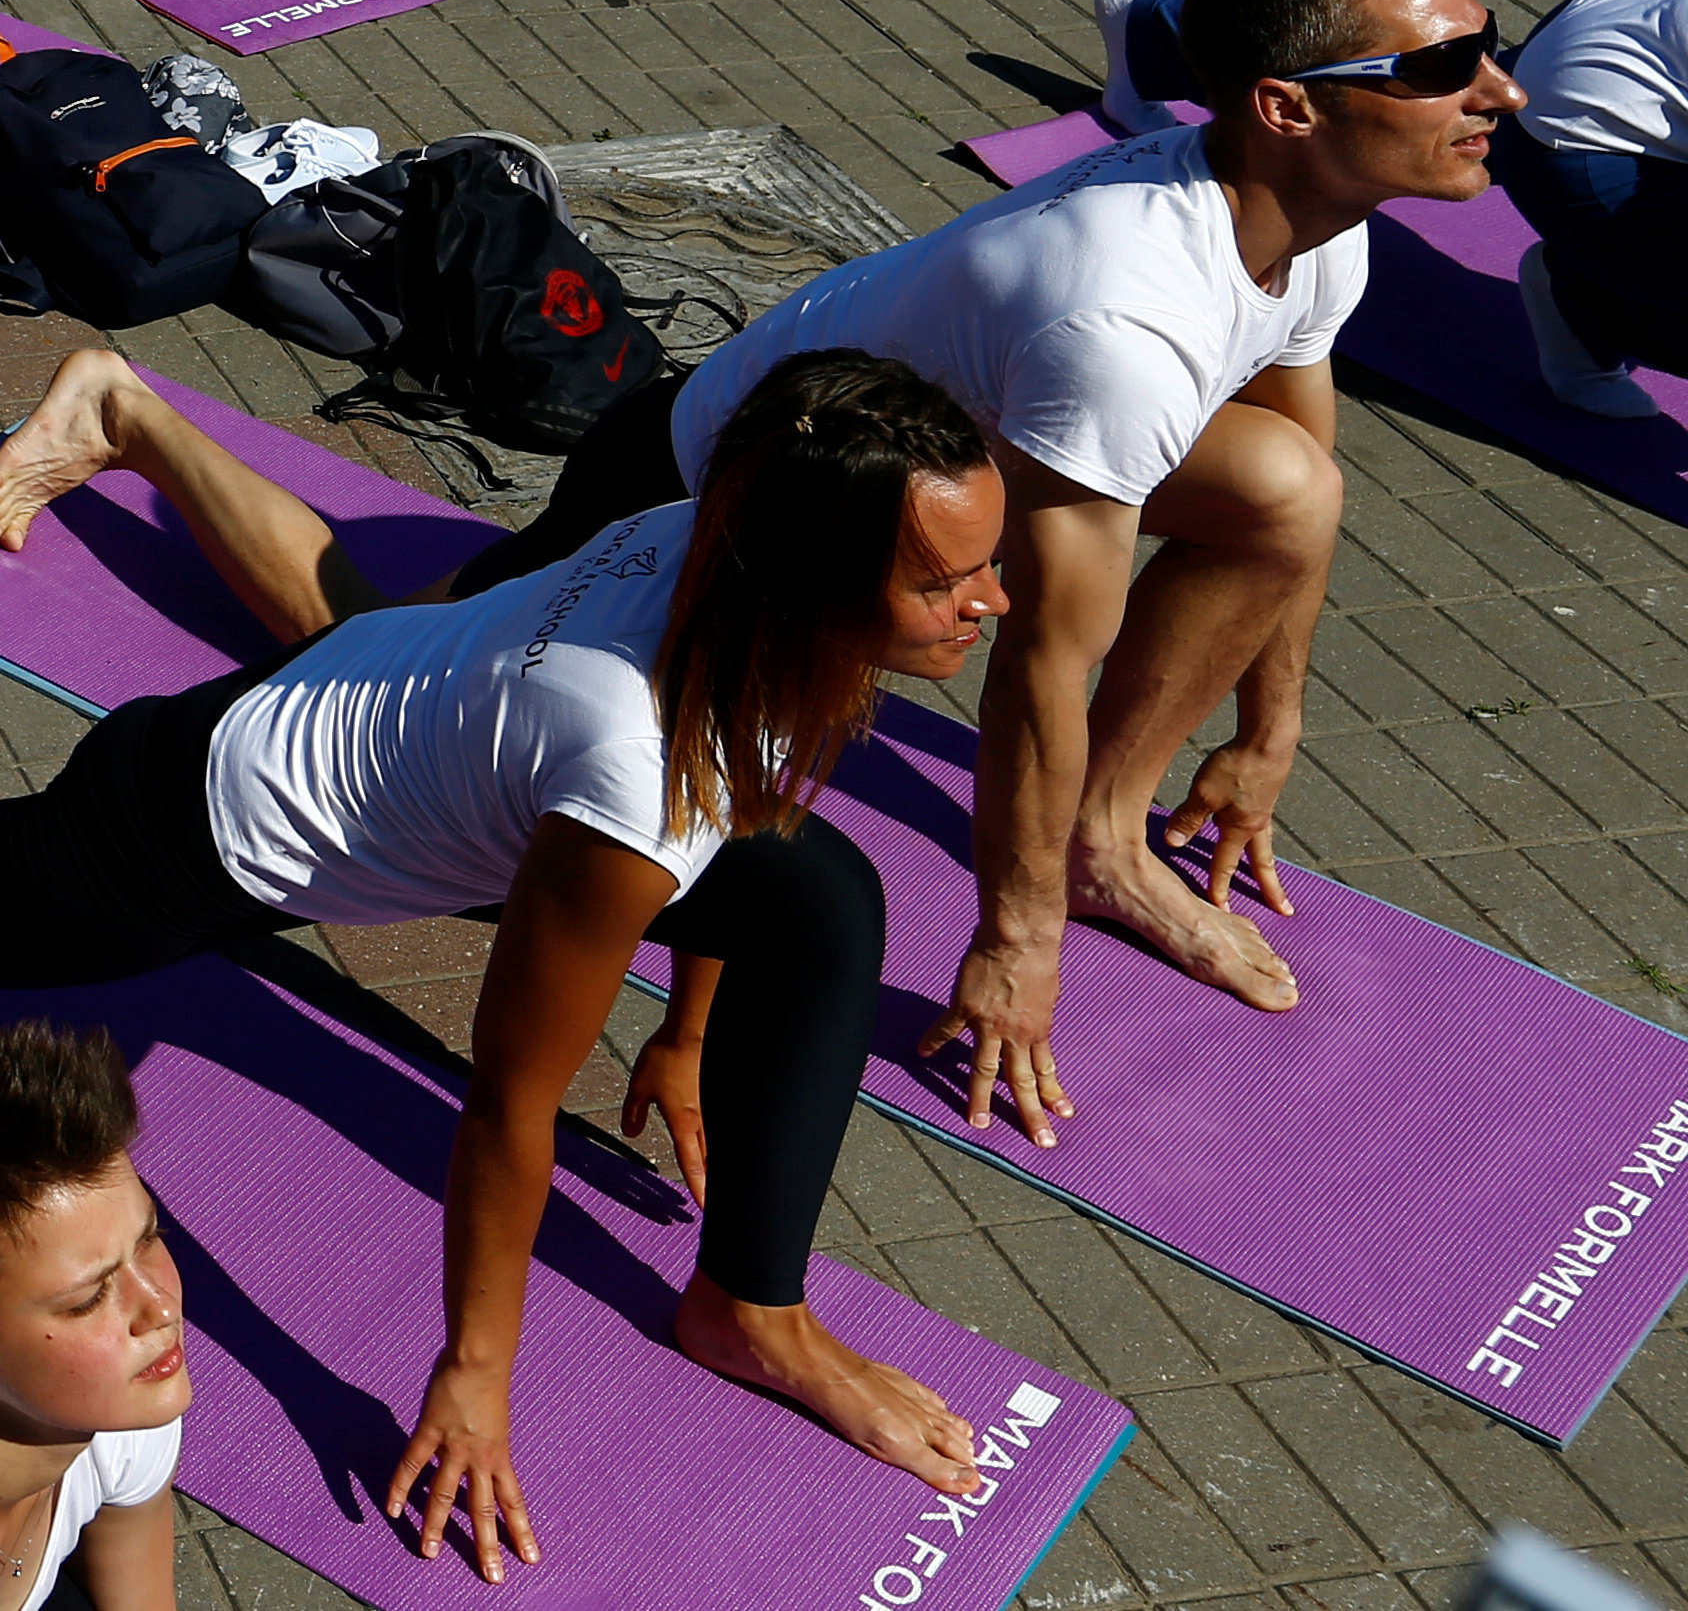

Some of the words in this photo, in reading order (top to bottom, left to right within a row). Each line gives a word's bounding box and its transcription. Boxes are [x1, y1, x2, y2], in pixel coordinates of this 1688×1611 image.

[521, 583, 591, 679] SCHOOL
[1620, 1098, 1688, 1189] ARK
[1465, 1181, 1654, 1389] FORMELLE
[920, 1416, 1042, 1538] MARK
